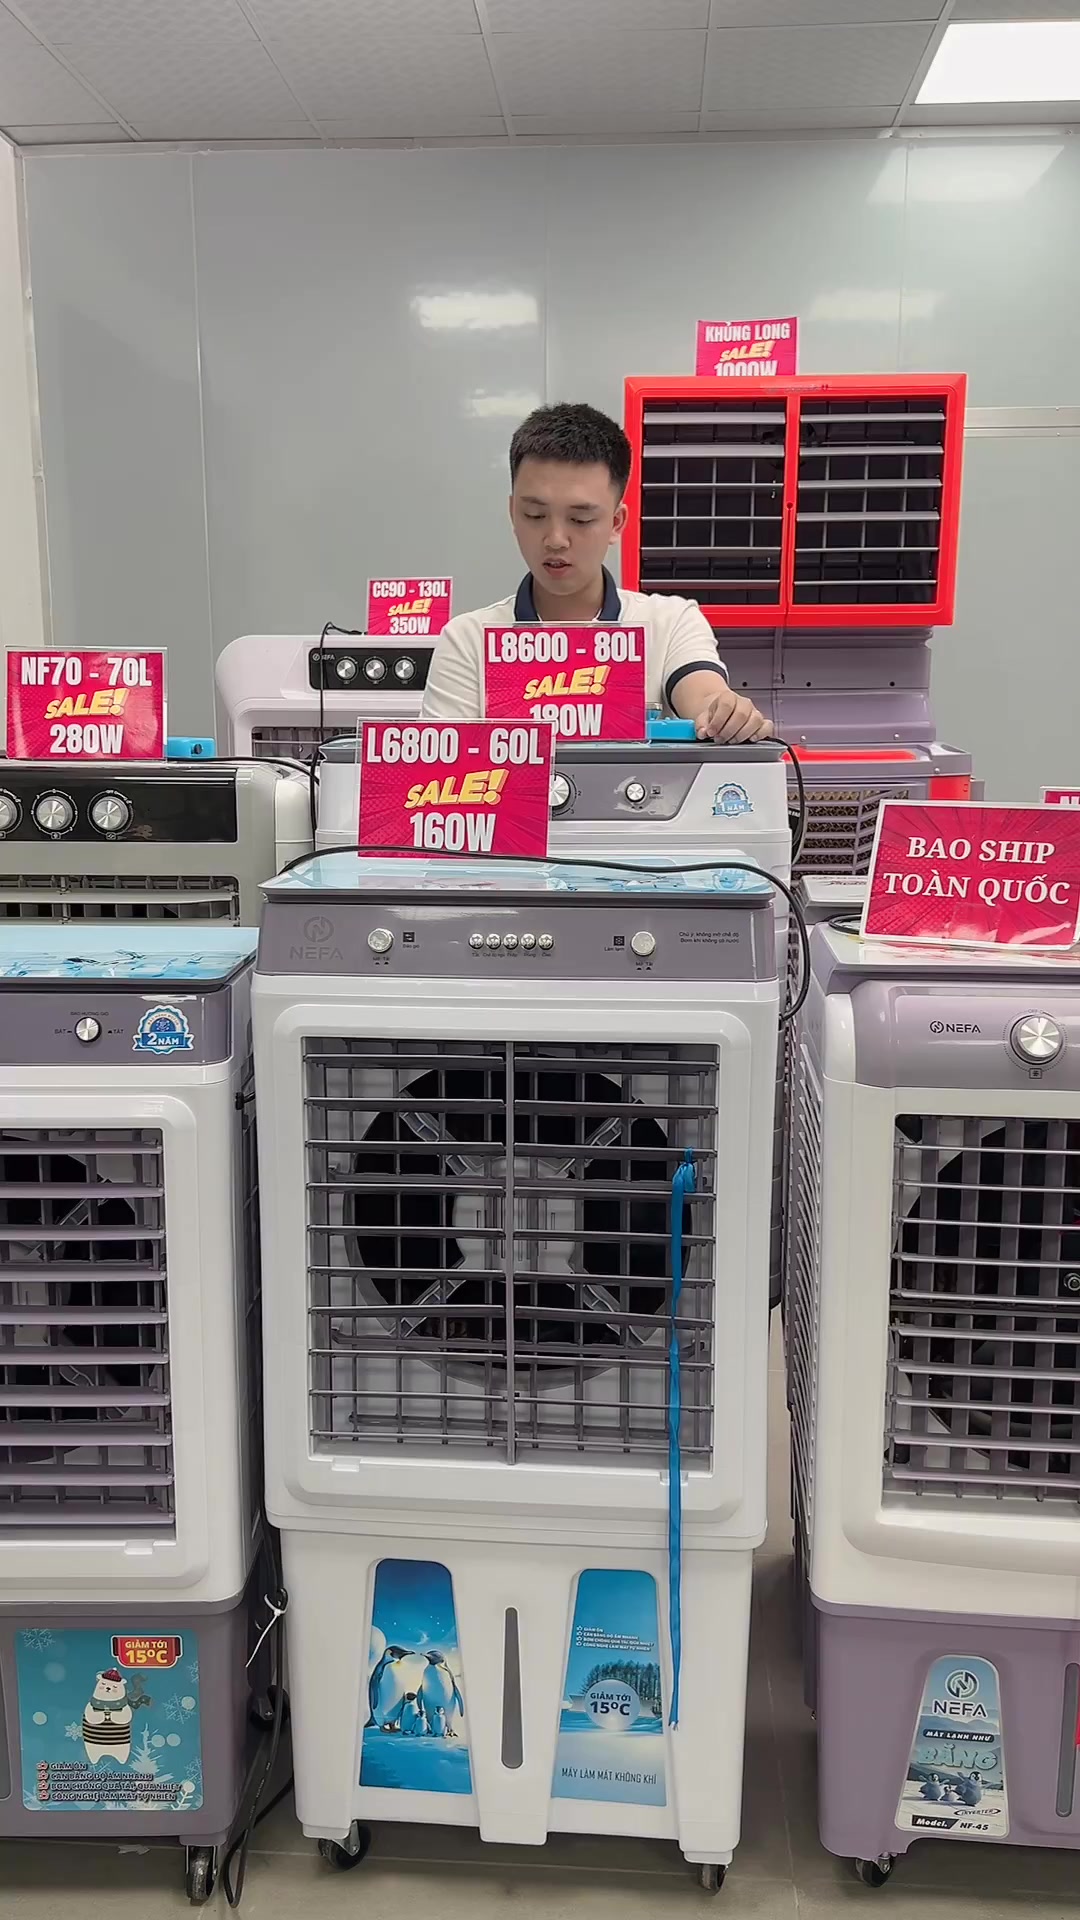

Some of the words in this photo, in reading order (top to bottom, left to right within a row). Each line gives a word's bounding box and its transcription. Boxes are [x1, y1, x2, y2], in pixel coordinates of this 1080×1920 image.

[705, 322, 751, 342] KHỦNG
[755, 323, 790, 341] LONG
[720, 340, 776, 363] SALE!
[714, 360, 778, 376] 1000W
[372, 581, 406, 598] CC90
[418, 580, 448, 598] 130L
[387, 598, 433, 616] SALE!
[389, 616, 431, 635] 350W
[487, 631, 568, 663] L8600
[594, 631, 642, 663] 80L
[20, 656, 82, 686] NF70
[107, 657, 152, 687] 70L
[523, 664, 612, 700] SALE!
[44, 687, 130, 719] SALE!
[529, 703, 603, 737] 180W
[49, 723, 124, 754] 280W
[366, 726, 459, 764] L6800
[489, 727, 545, 765] 60L
[403, 768, 510, 809] SALE!
[409, 811, 497, 852] 160W
[906, 836, 972, 860] BAO
[978, 839, 1056, 864] SHIP
[883, 869, 971, 898] TOÀN
[978, 873, 1071, 907] QUỐC
[289, 946, 344, 960] NEFA
[946, 1023, 981, 1033] NEFA
[146, 1032, 158, 1046] 2
[157, 1036, 180, 1045] NĂM
[125, 1639, 150, 1649] GIẢM
[151, 1639, 168, 1649] TỚI
[590, 1691, 614, 1700] GIẢM
[615, 1693, 632, 1702] TỚI
[933, 1700, 987, 1718] NEFA
[917, 1742, 998, 1770] BĂNG
[561, 1766, 578, 1777] MÁY
[579, 1767, 596, 1779] LÀM
[597, 1768, 613, 1780] MÁT
[614, 1771, 642, 1783] KHÔNG
[643, 1773, 657, 1784] KHÍ
[916, 1818, 948, 1828] Model.
[959, 1822, 990, 1831] NF-45
